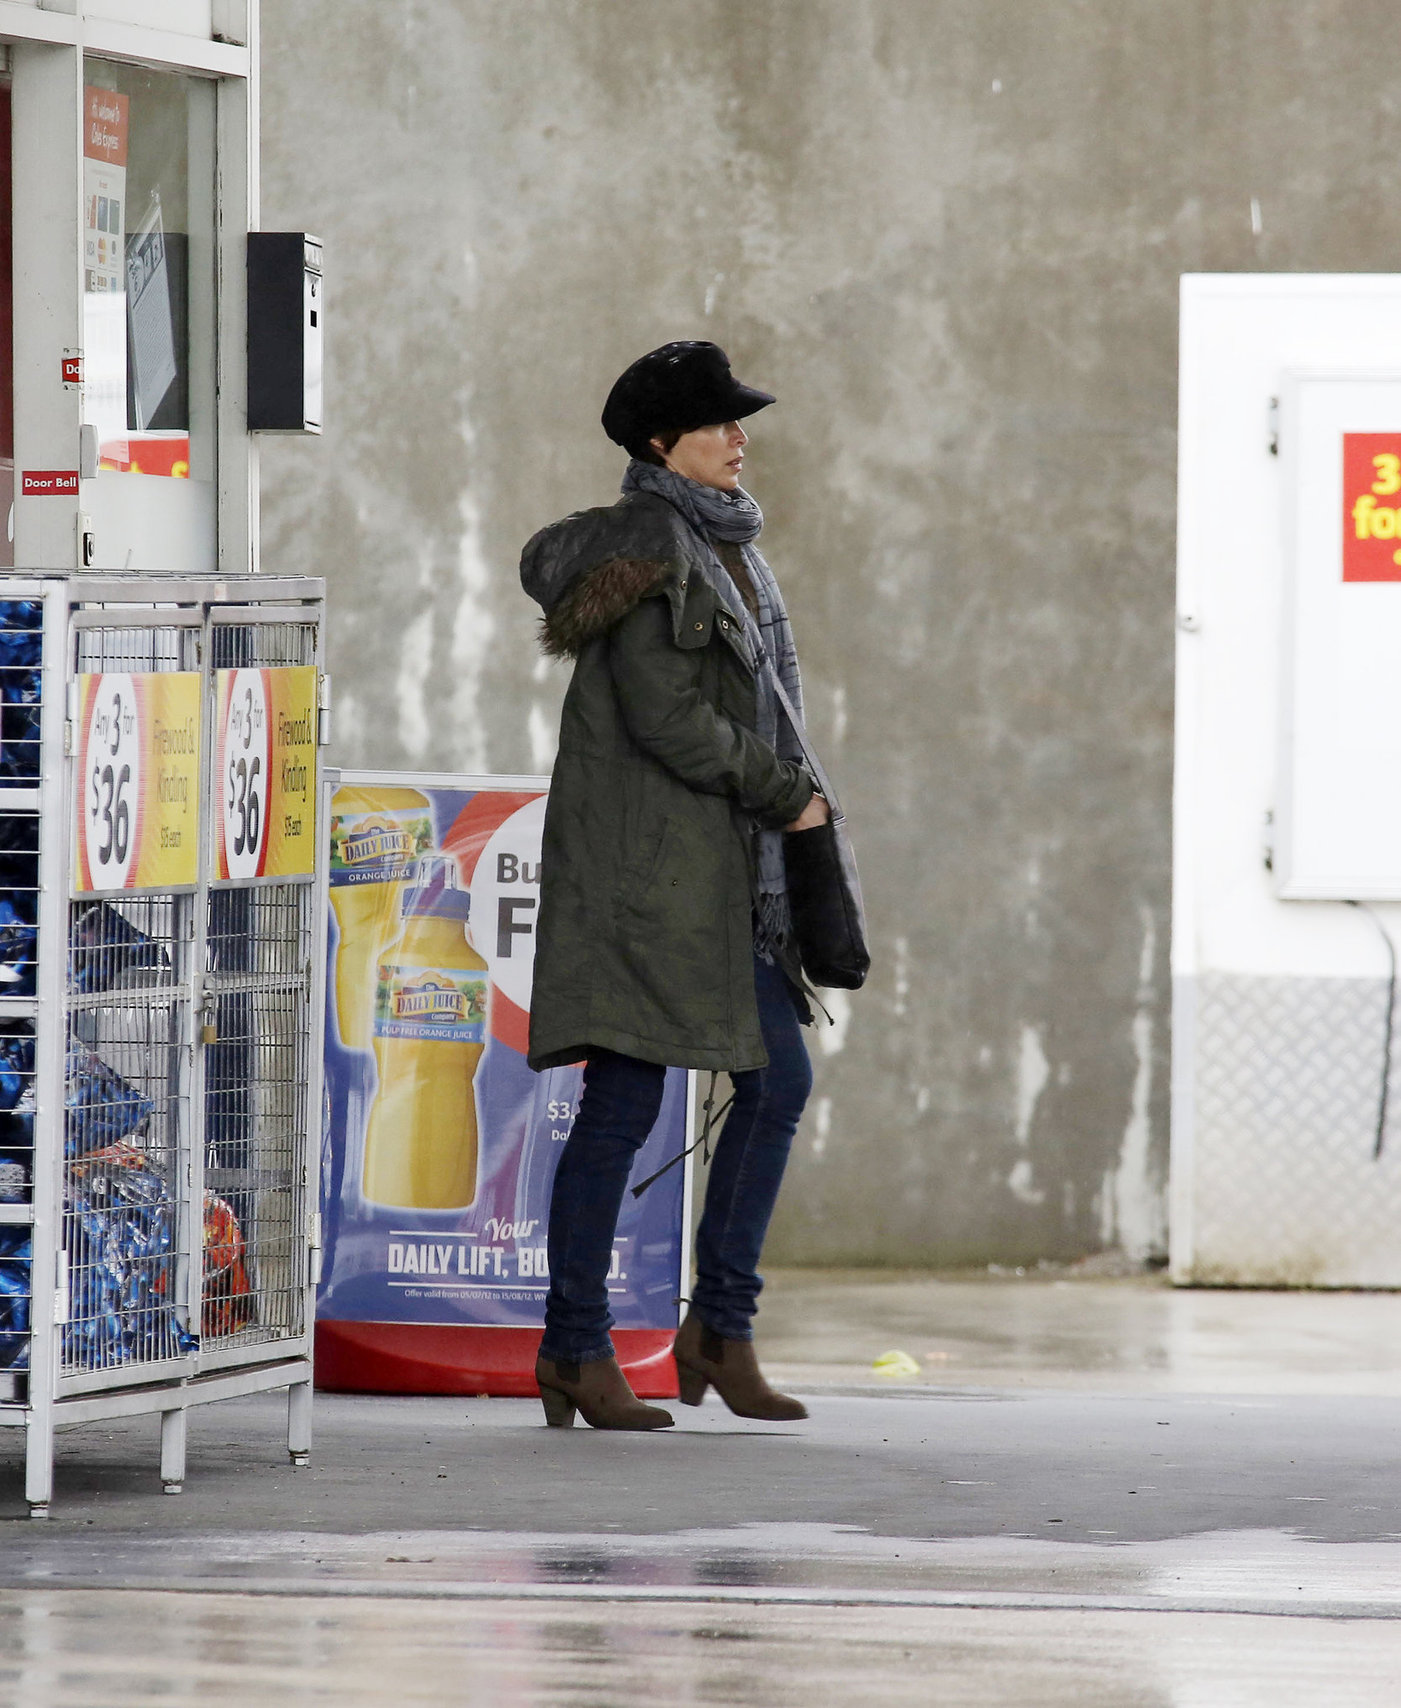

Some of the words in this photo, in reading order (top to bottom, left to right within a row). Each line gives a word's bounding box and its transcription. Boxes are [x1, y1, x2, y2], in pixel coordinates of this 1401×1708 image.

[66, 364, 80, 374] Do
[24, 478, 53, 488] Door
[55, 477, 76, 487] Bell
[94, 706, 110, 744] Any
[110, 693, 121, 756] 3
[122, 705, 135, 736] for
[230, 702, 243, 738] Any
[243, 687, 252, 749] 3
[253, 699, 263, 728] for
[278, 708, 306, 747] Firewood
[157, 766, 187, 814] Kindling
[281, 755, 306, 802] Kindling
[91, 756, 130, 865] $36
[228, 750, 260, 856] $36
[345, 840, 377, 861] DAILY
[380, 834, 409, 853] JUICE
[348, 871, 385, 881] ORANGE
[387, 869, 411, 880] JUICE
[497, 853, 542, 884] Bu
[396, 994, 430, 1013] DAILY
[433, 994, 463, 1011] JUICE
[381, 1026, 400, 1034] PULP
[401, 1027, 418, 1036] FREE
[419, 1029, 451, 1038] ORANGE
[453, 1031, 473, 1039] JUICE
[547, 1099, 576, 1121] $3.
[484, 1216, 539, 1241] Your
[387, 1243, 453, 1274] DAILY
[457, 1245, 509, 1278] LIFT,
[404, 1289, 422, 1297] Offer
[423, 1290, 441, 1298] valid
[441, 1290, 459, 1299] from
